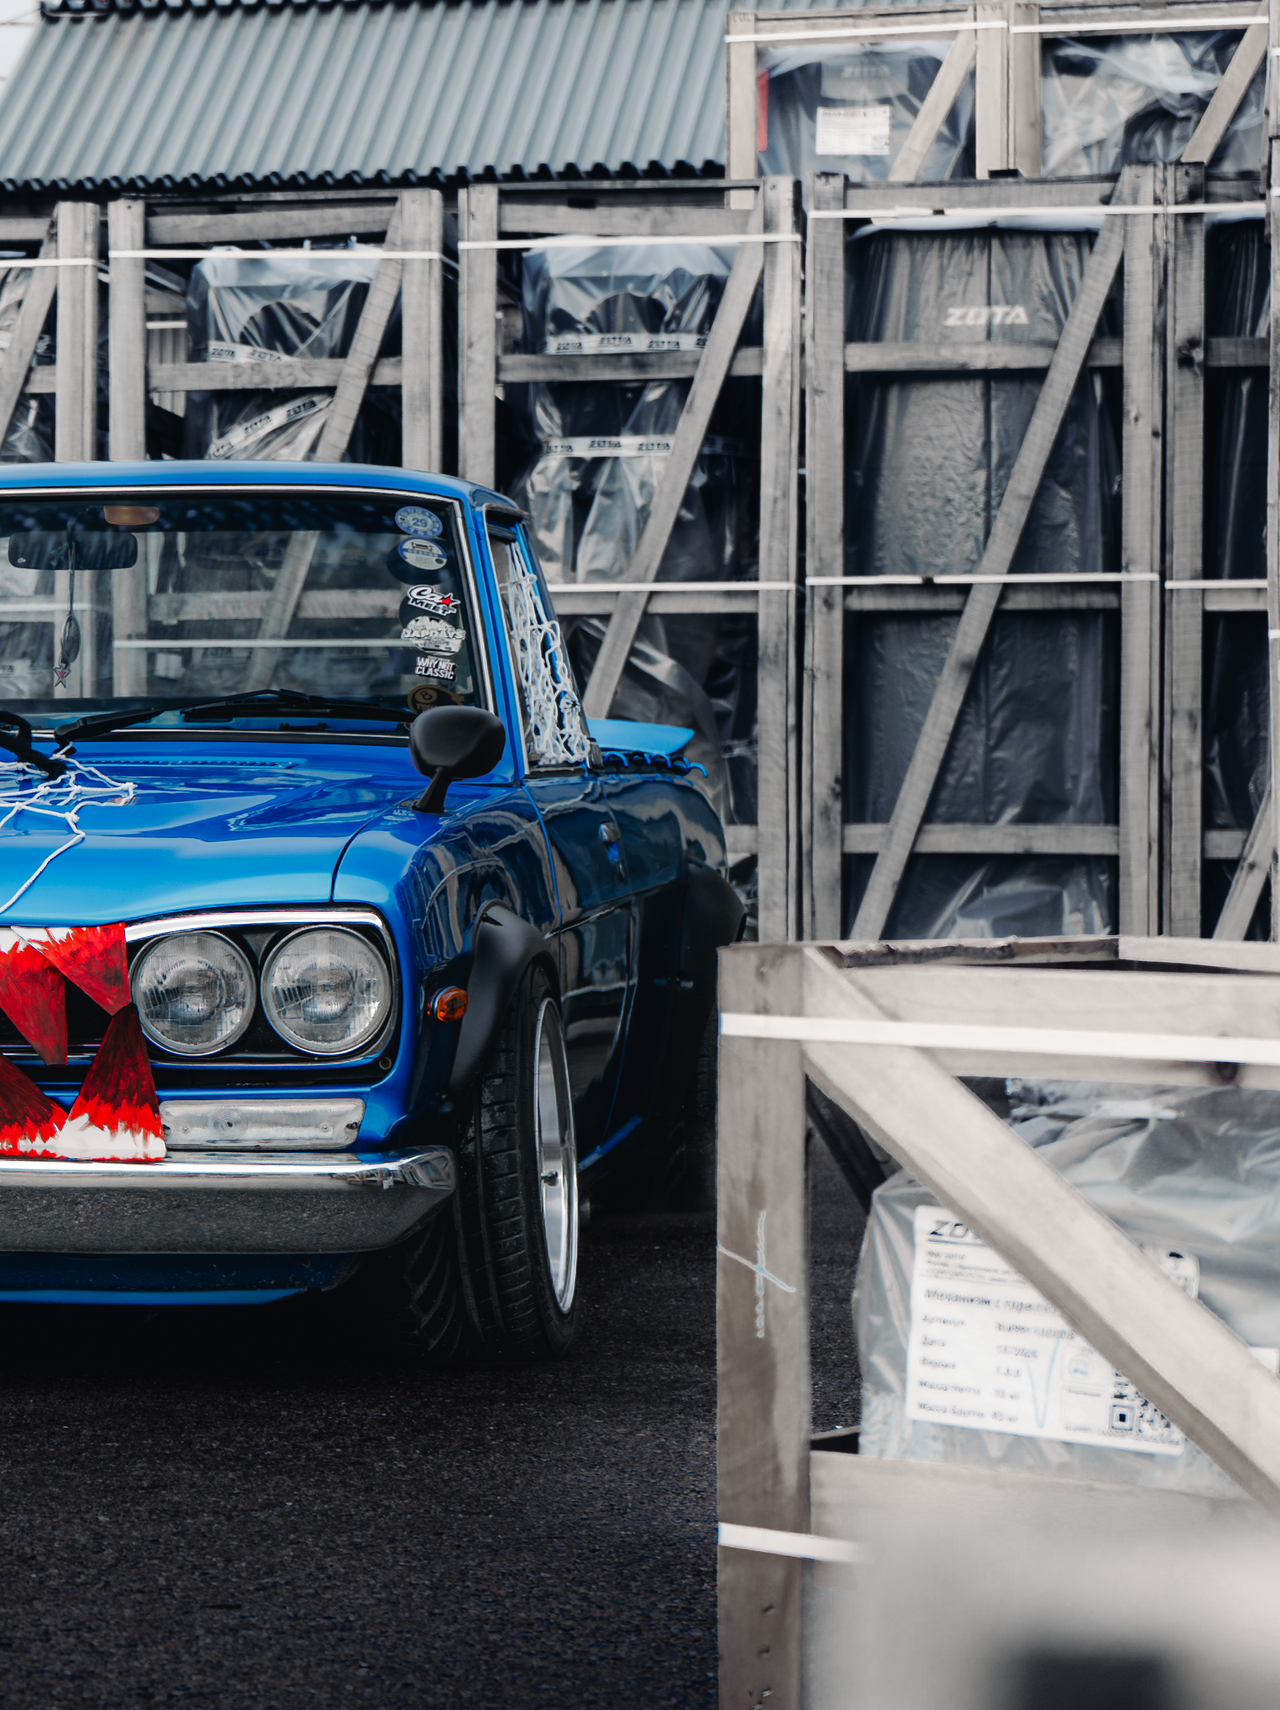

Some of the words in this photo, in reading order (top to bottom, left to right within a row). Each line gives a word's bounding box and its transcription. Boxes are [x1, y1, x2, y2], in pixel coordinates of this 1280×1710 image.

[943, 304, 1030, 326] ZOTA
[411, 517, 428, 528] 29
[415, 666, 455, 679] CLASSIC
